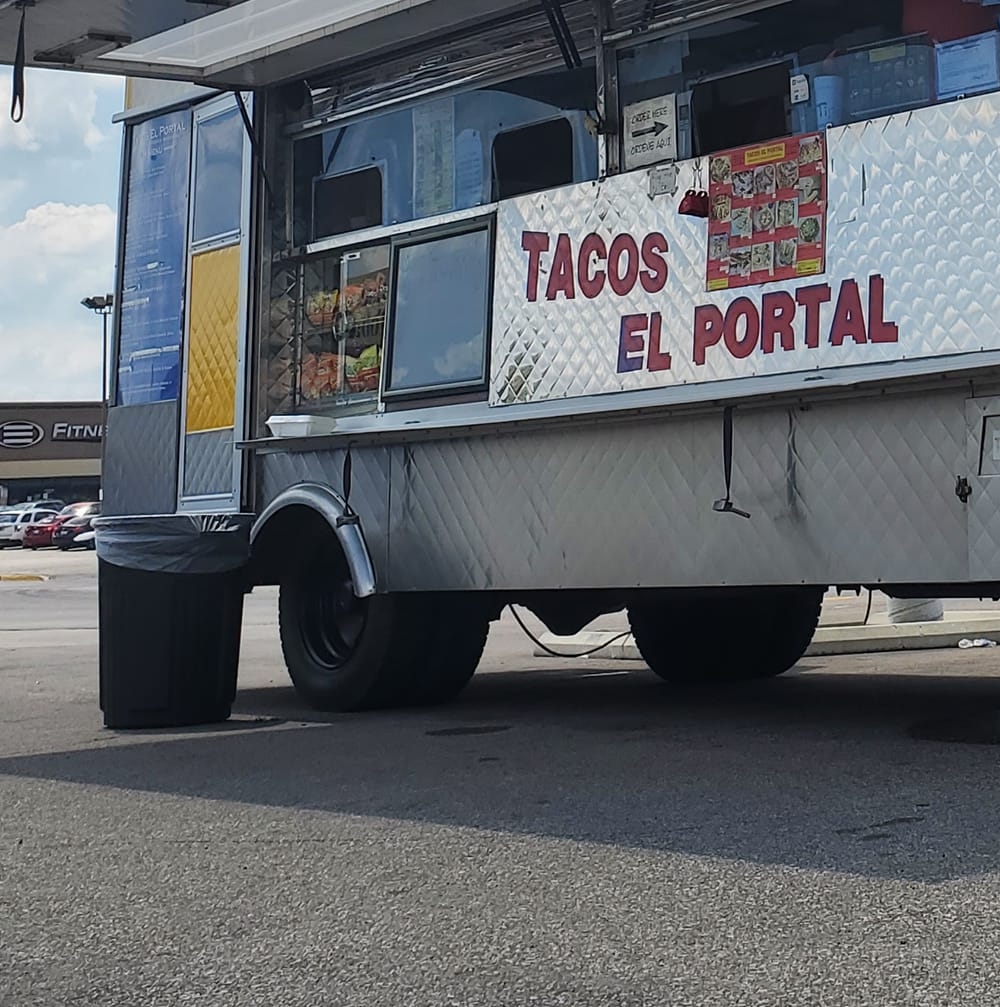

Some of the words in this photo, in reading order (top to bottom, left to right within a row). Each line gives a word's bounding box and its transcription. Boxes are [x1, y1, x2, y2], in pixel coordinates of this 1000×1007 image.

[521, 231, 668, 302] TACOS
[617, 311, 671, 373] EL
[692, 274, 898, 365] PORTAL
